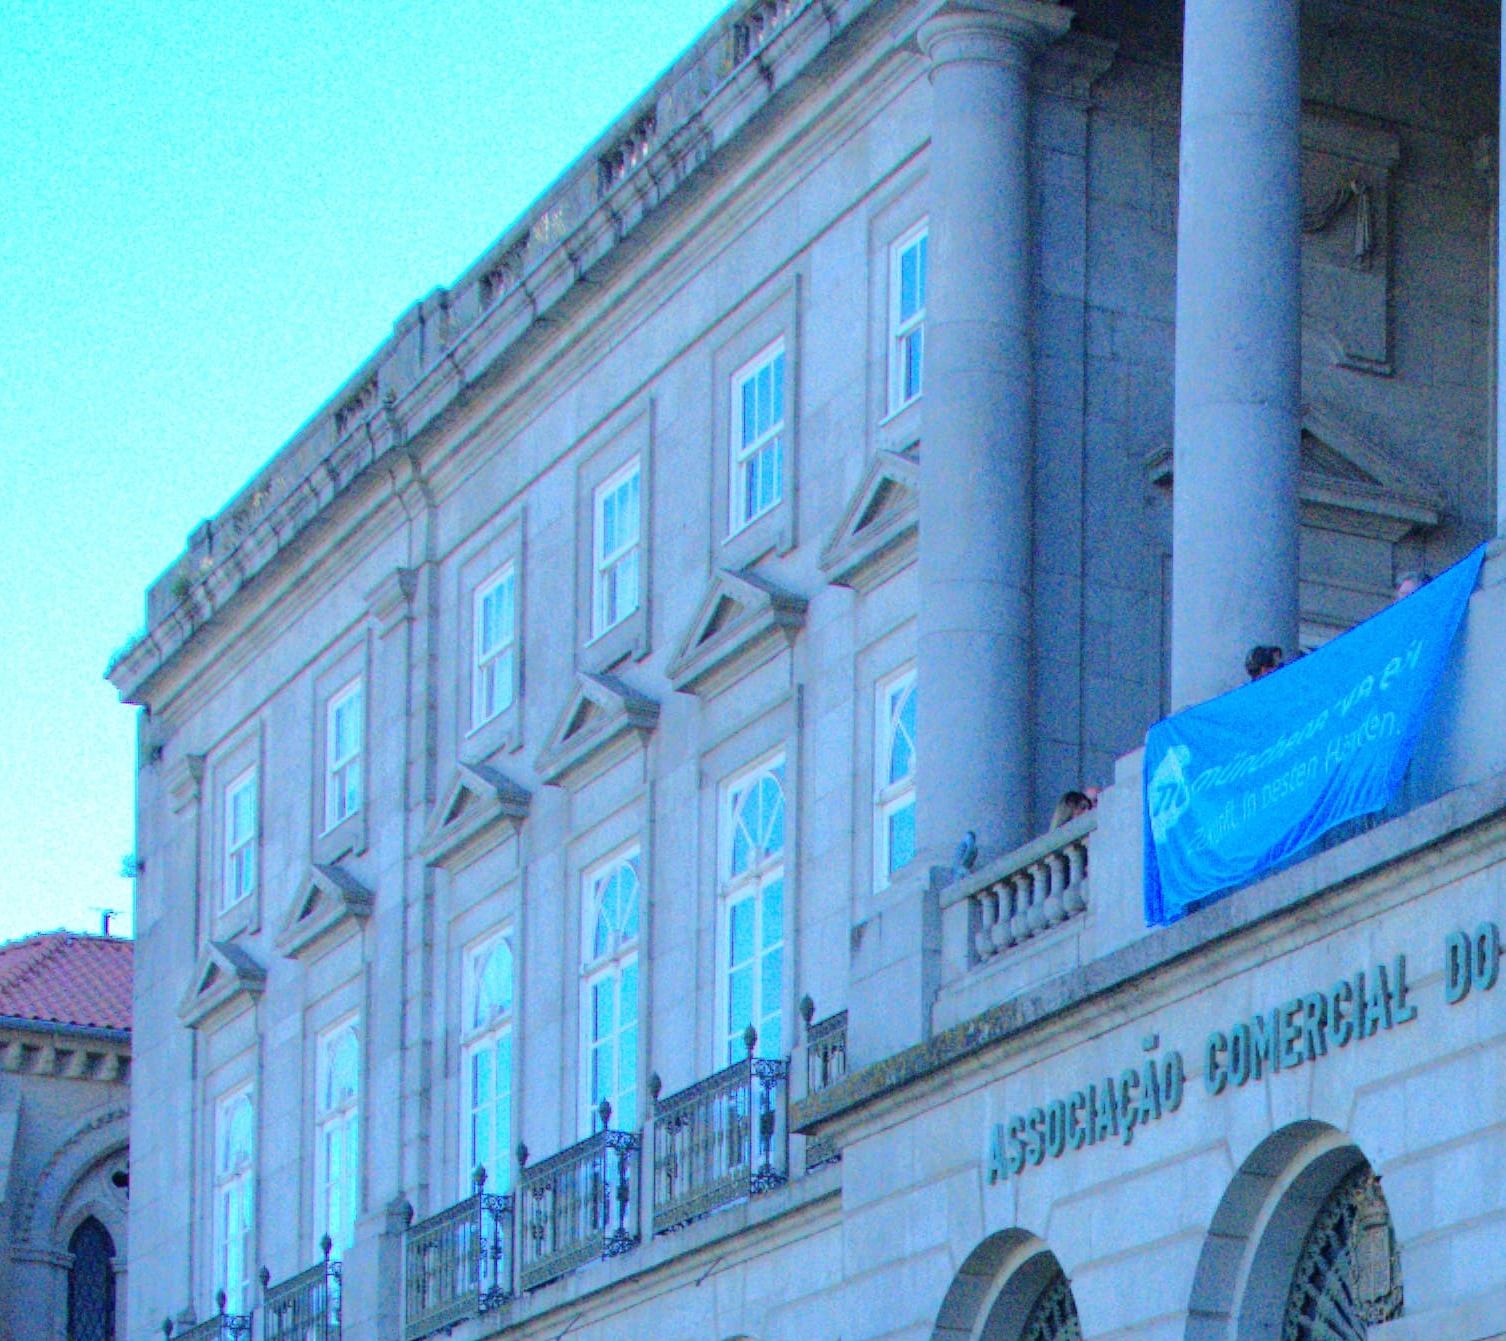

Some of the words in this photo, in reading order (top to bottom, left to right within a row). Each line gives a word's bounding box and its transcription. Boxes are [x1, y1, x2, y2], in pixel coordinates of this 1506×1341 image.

[987, 1032, 1184, 1186] ASSOCIAÇÃO
[1205, 954, 1418, 1097] COMERCIAL
[1445, 921, 1501, 1006] DO
